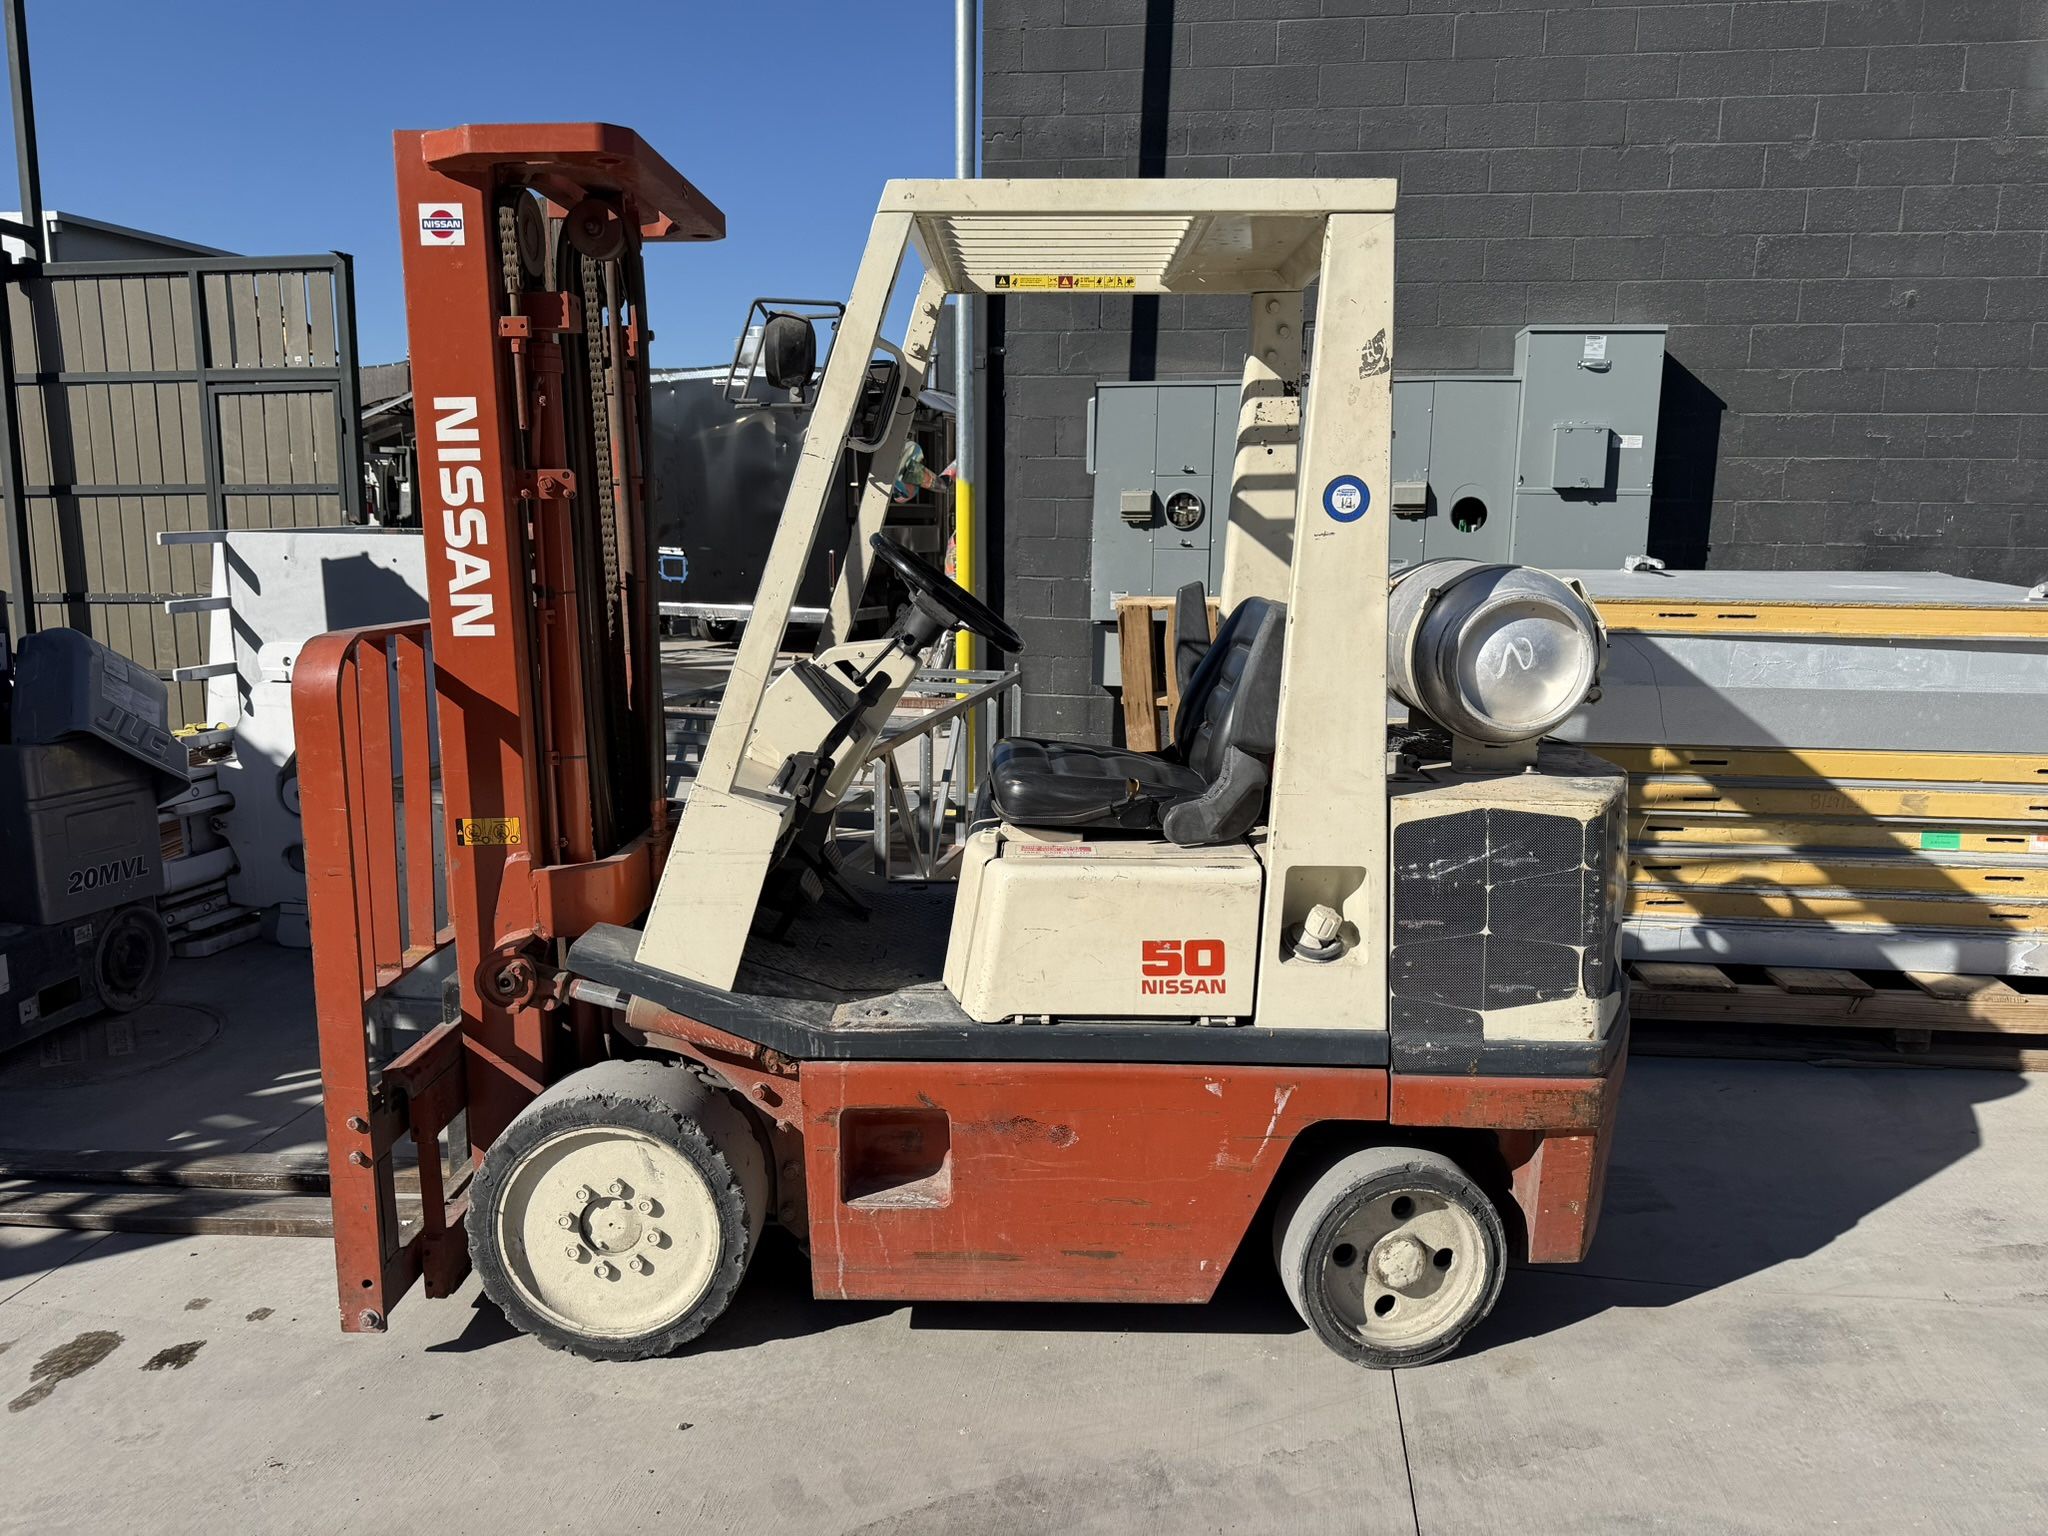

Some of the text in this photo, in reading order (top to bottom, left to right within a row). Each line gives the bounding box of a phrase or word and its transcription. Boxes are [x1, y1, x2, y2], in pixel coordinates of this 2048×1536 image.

[424, 219, 460, 228] NISSAN
[433, 396, 496, 638] NISSAN
[94, 706, 172, 761] JLG
[66, 854, 150, 897] 20MVL
[1142, 939, 1226, 977] 50
[1141, 979, 1227, 995] NISSAN
